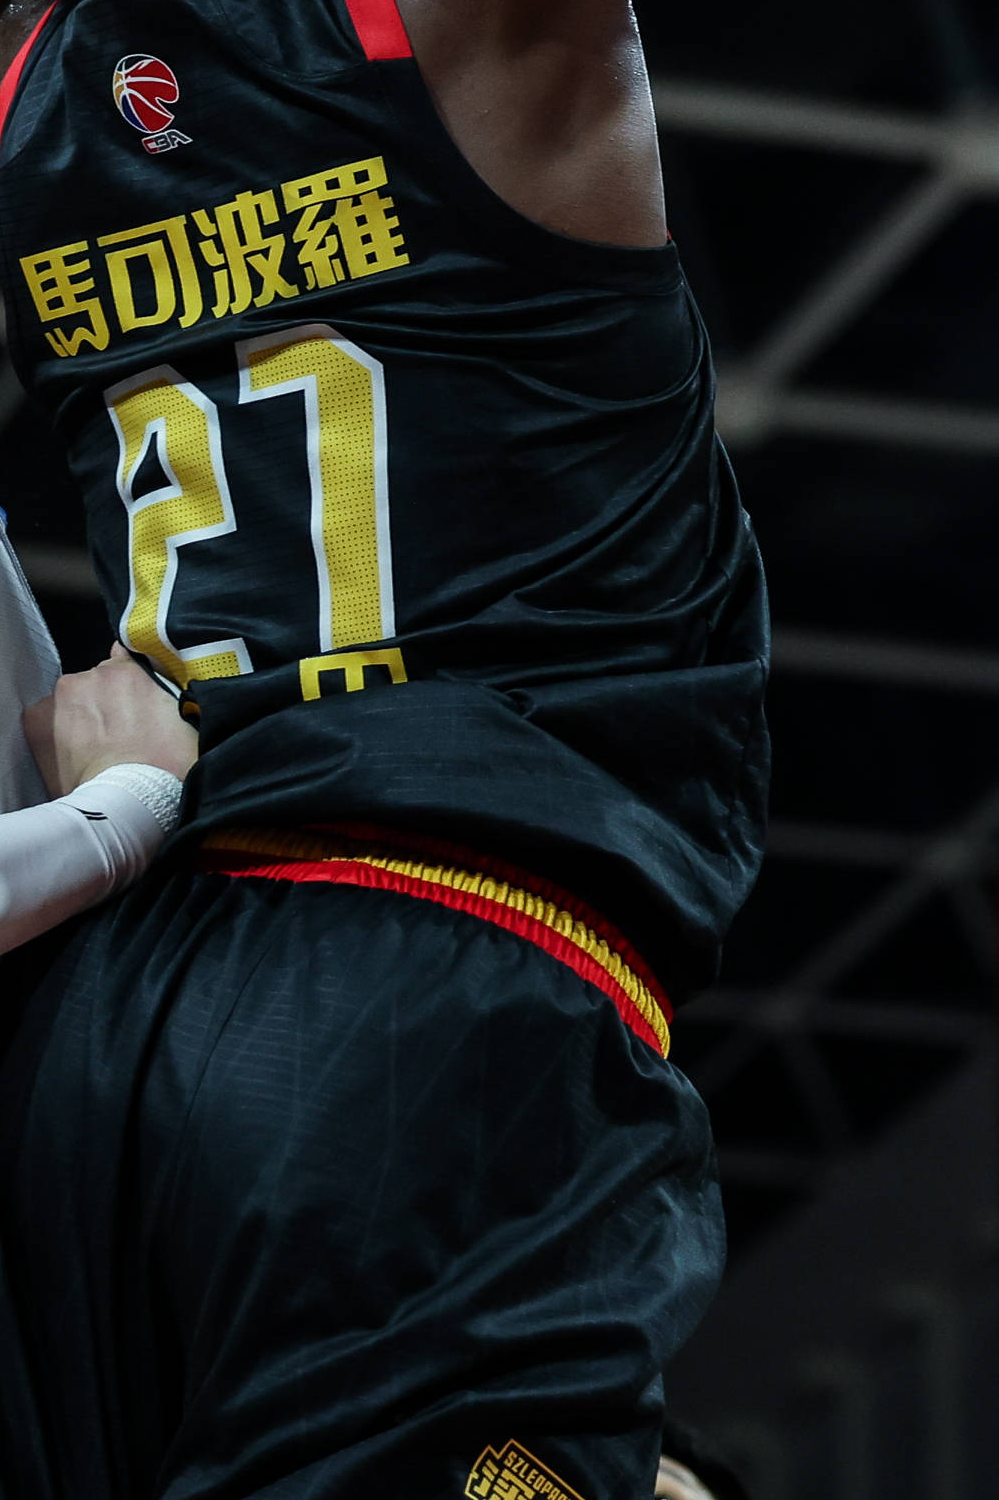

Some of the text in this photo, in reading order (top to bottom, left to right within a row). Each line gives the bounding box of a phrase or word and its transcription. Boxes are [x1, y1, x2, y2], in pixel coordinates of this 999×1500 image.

[141, 129, 193, 154] CBA
[19, 155, 410, 357] 馬可波羅
[103, 324, 392, 692] 27
